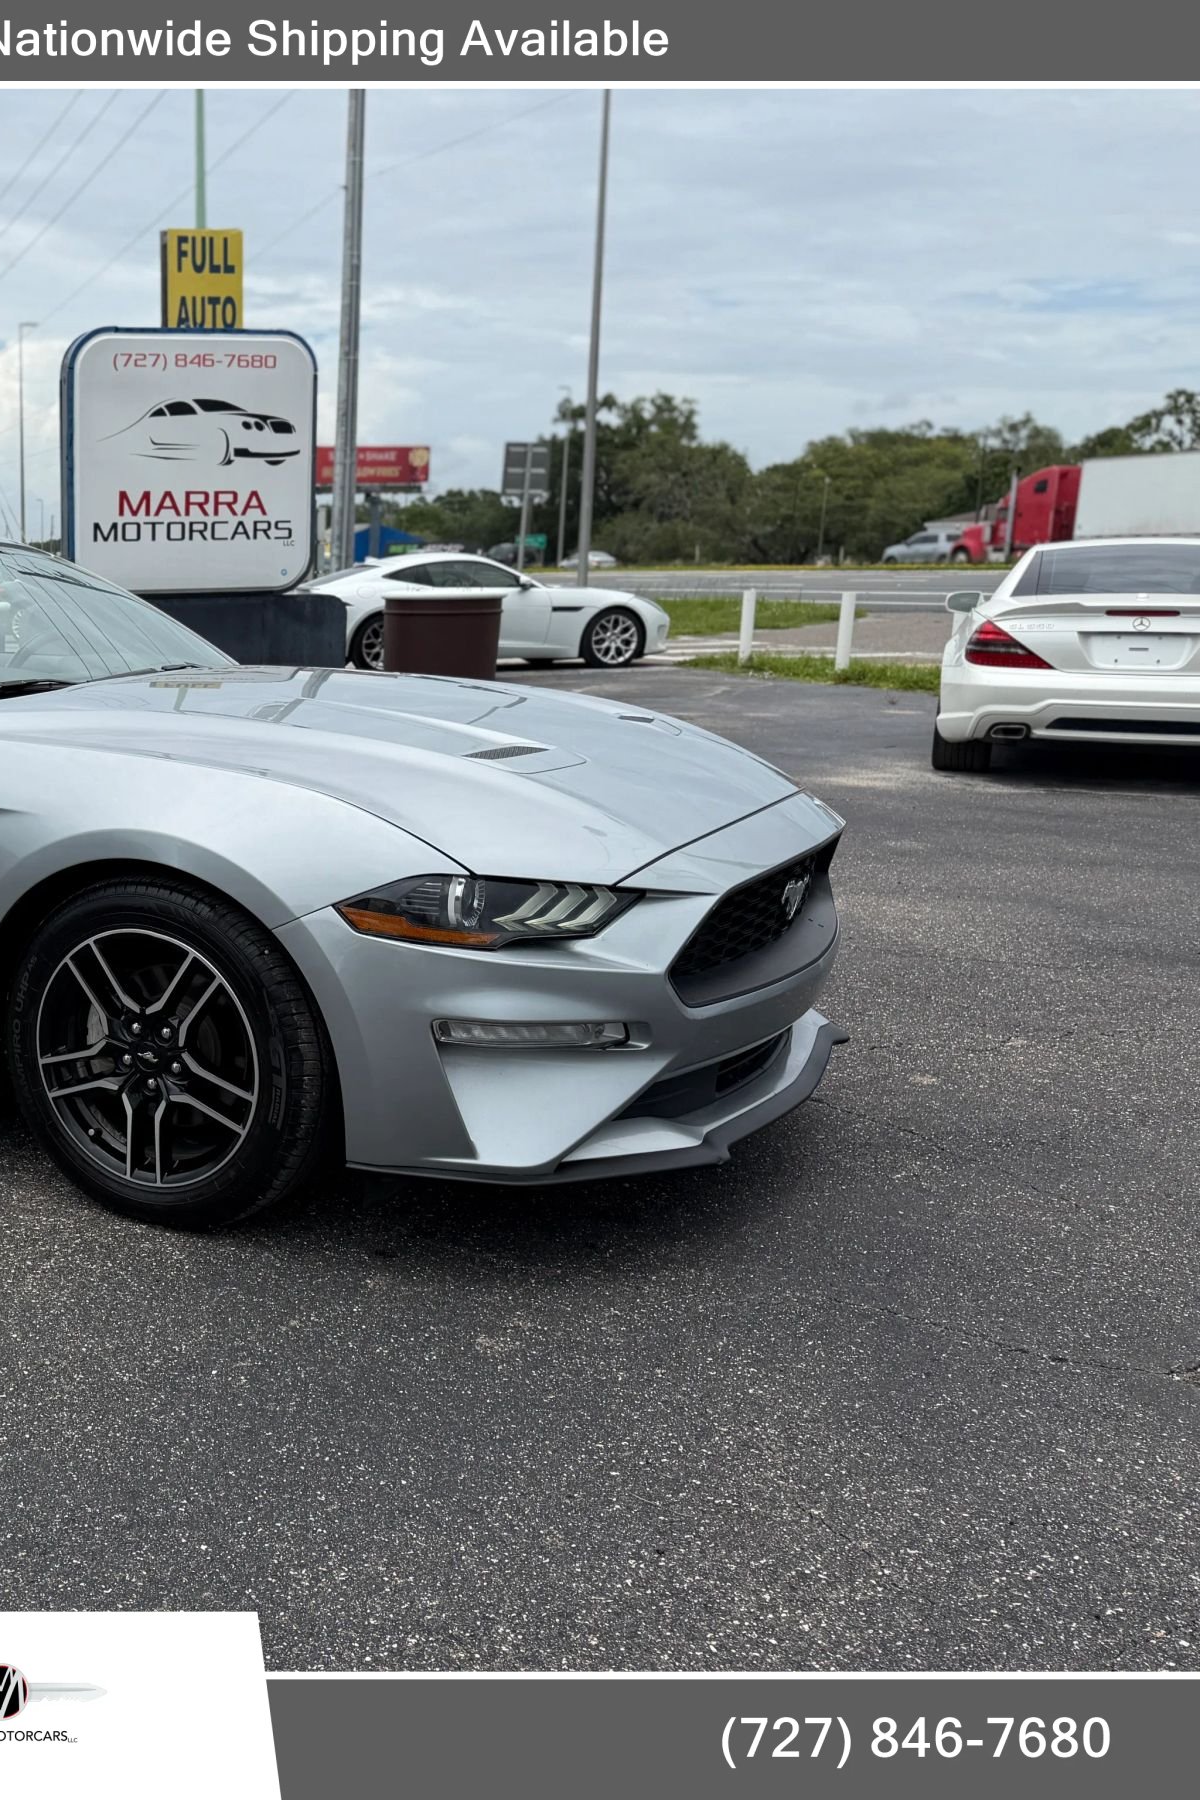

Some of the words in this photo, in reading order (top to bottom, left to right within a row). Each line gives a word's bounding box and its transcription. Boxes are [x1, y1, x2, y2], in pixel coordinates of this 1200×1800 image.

[176, 236, 236, 274] FULL
[176, 296, 237, 329] AUTO
[112, 353, 168, 371] (727)
[175, 353, 278, 370] 846-7680
[117, 490, 268, 517] MARRA
[92, 520, 293, 543] MOTORCARS
[282, 539, 296, 547] LLC
